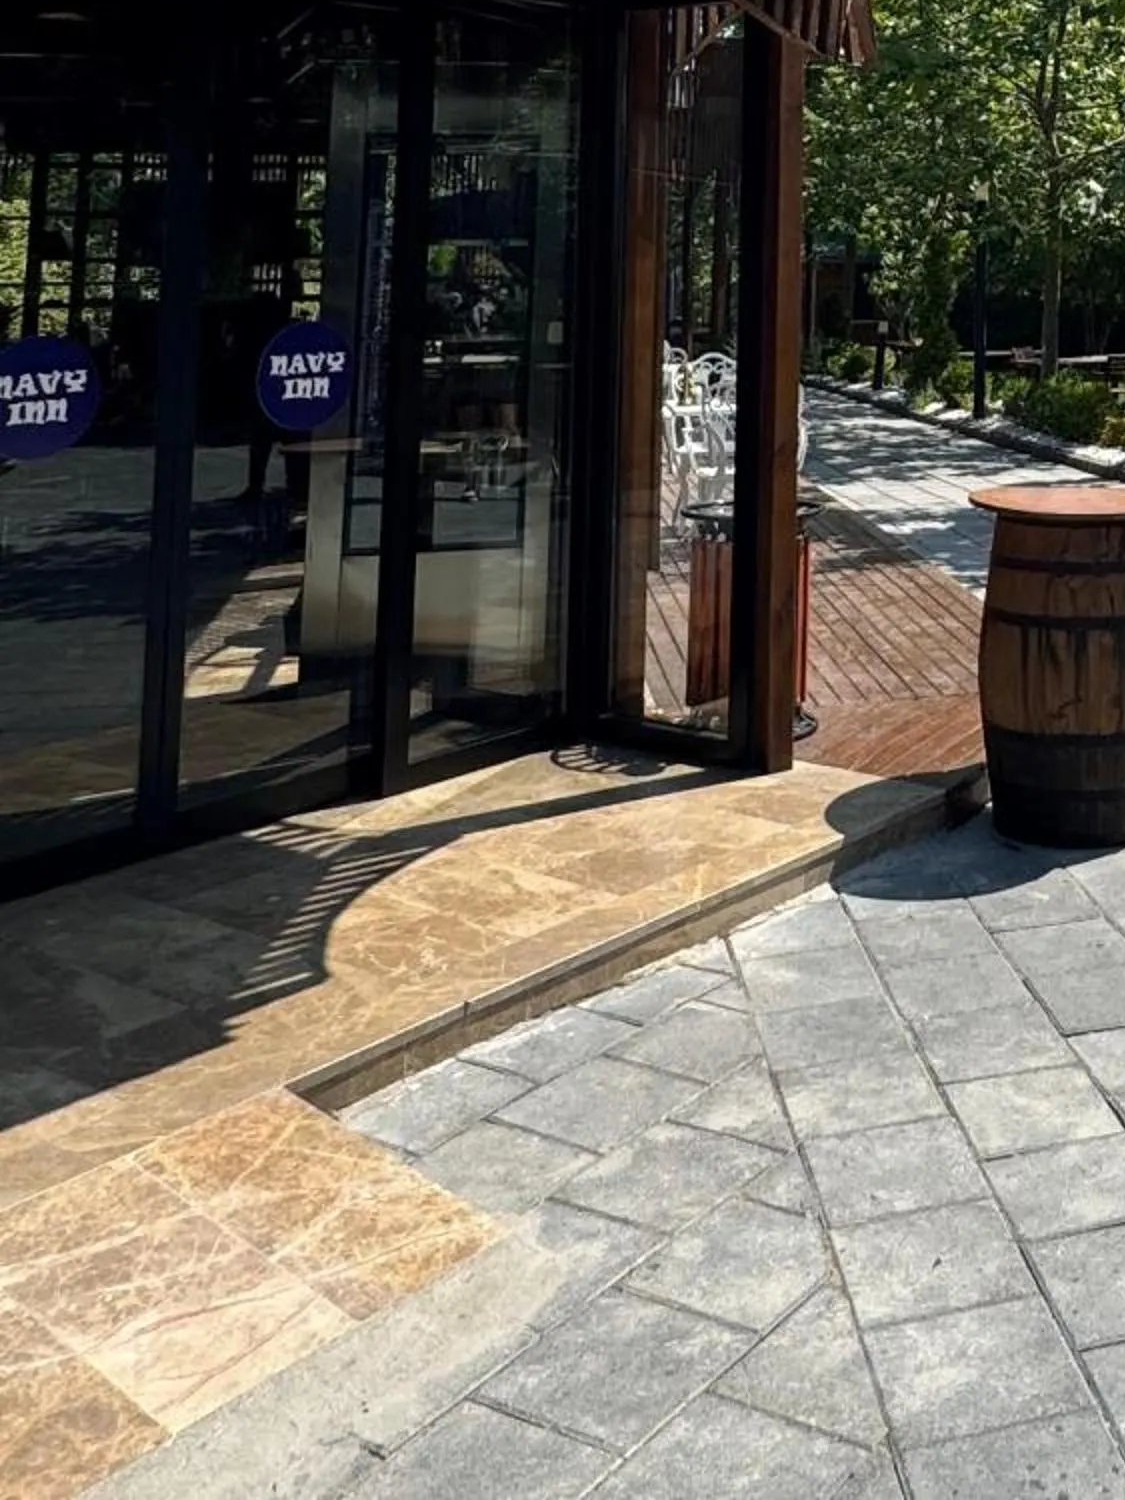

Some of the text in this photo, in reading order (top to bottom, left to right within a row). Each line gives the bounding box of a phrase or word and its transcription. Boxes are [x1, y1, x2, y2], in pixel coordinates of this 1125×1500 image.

[269, 351, 346, 376] NAVY
[281, 376, 331, 400] INN
[6, 398, 68, 426] INN
